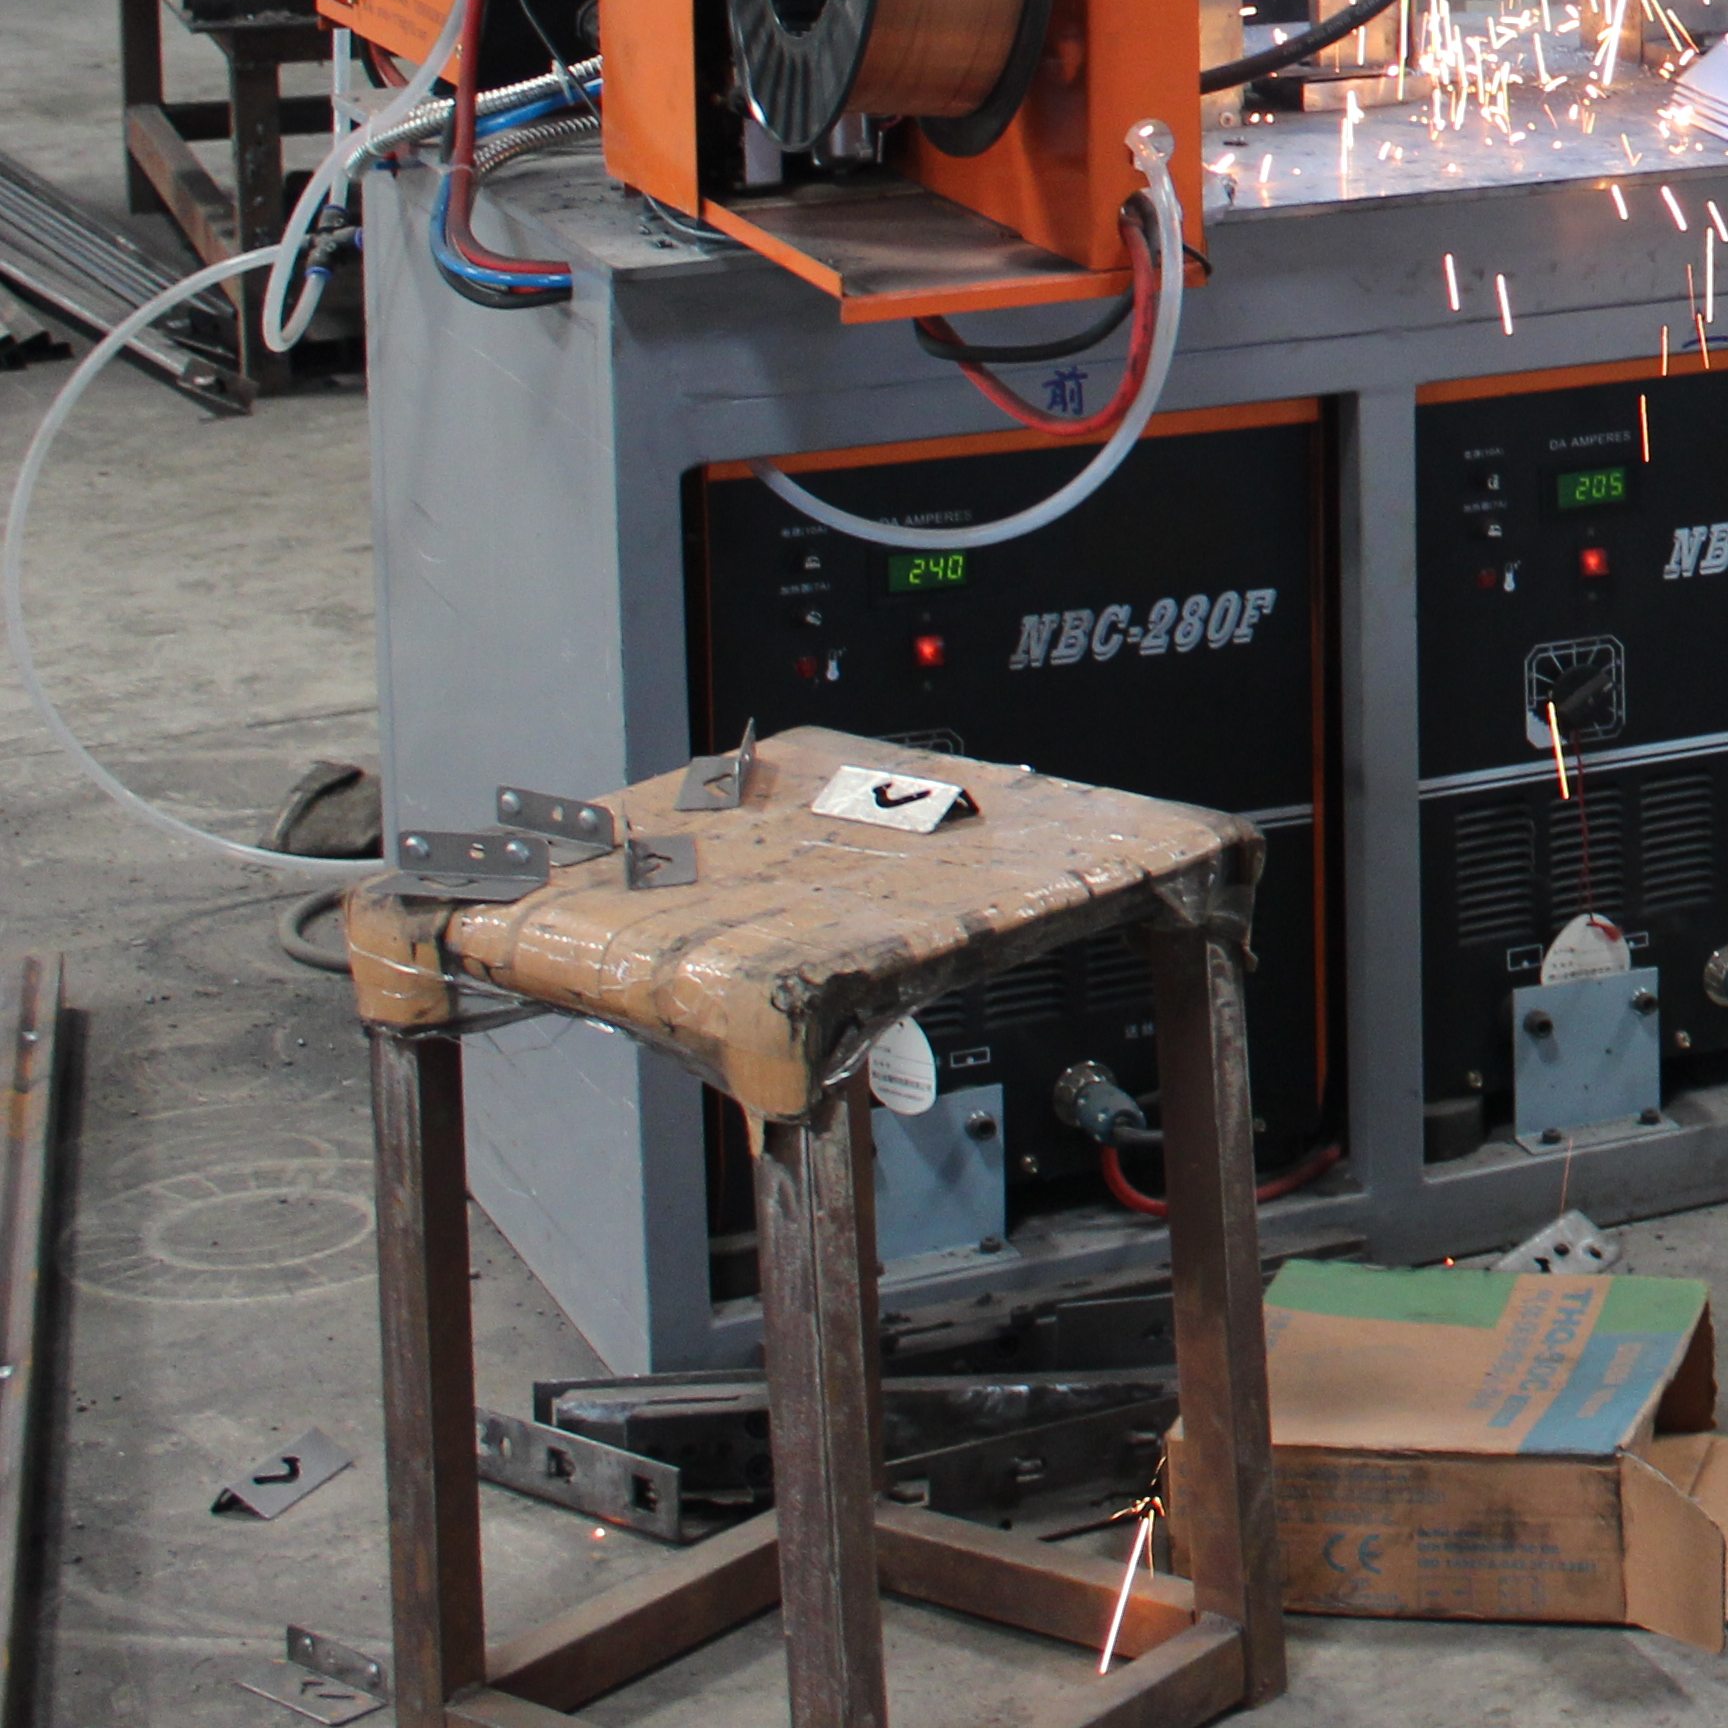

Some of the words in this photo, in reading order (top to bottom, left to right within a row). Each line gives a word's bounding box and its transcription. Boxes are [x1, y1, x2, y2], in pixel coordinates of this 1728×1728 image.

[1041, 365, 1089, 416] 前
[1570, 430, 1632, 449] AMPERES
[1574, 473, 1623, 502] 205
[904, 508, 974, 527] AMPERES
[908, 554, 965, 586] 240
[1008, 585, 1277, 671] NBC-280F
